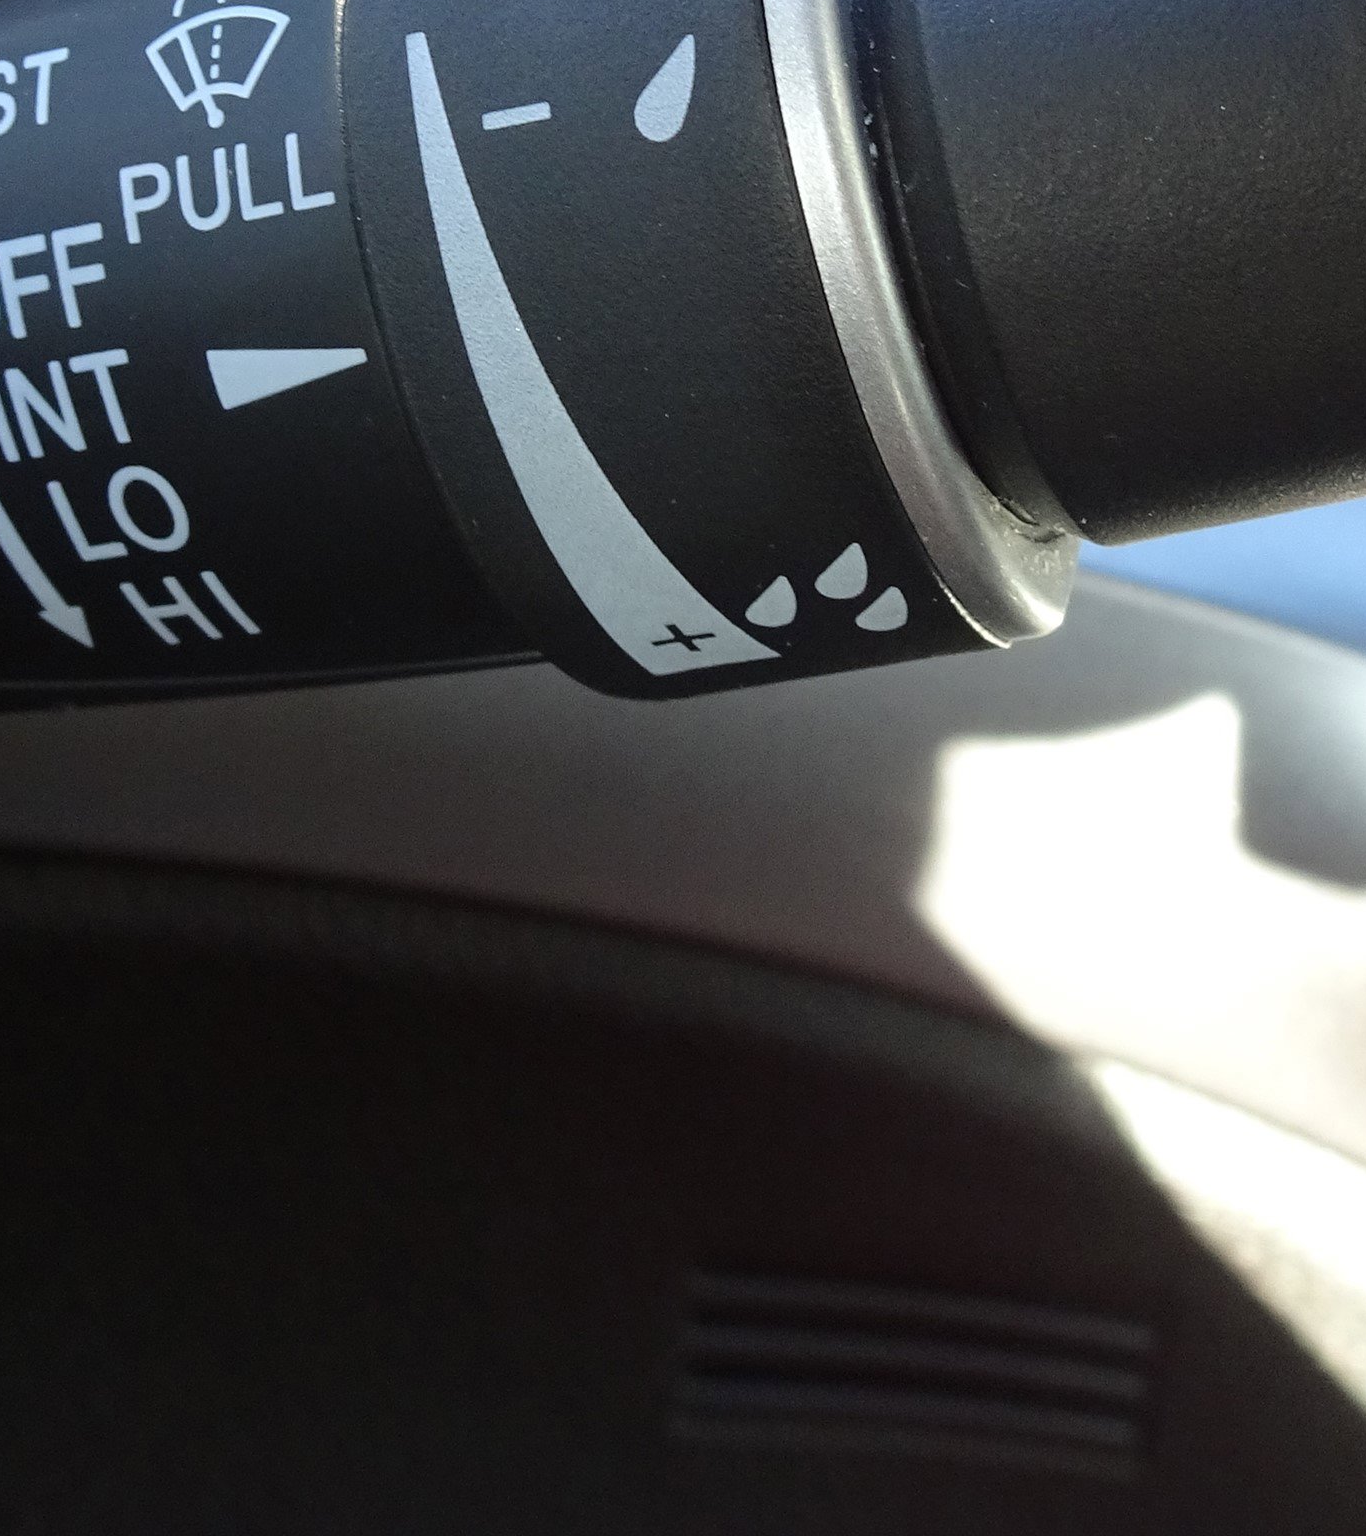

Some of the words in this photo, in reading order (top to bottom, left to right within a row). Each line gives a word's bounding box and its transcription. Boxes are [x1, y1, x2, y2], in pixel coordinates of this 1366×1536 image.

[118, 132, 336, 244] PULL
[46, 465, 190, 562] LO
[119, 570, 263, 646] HI
